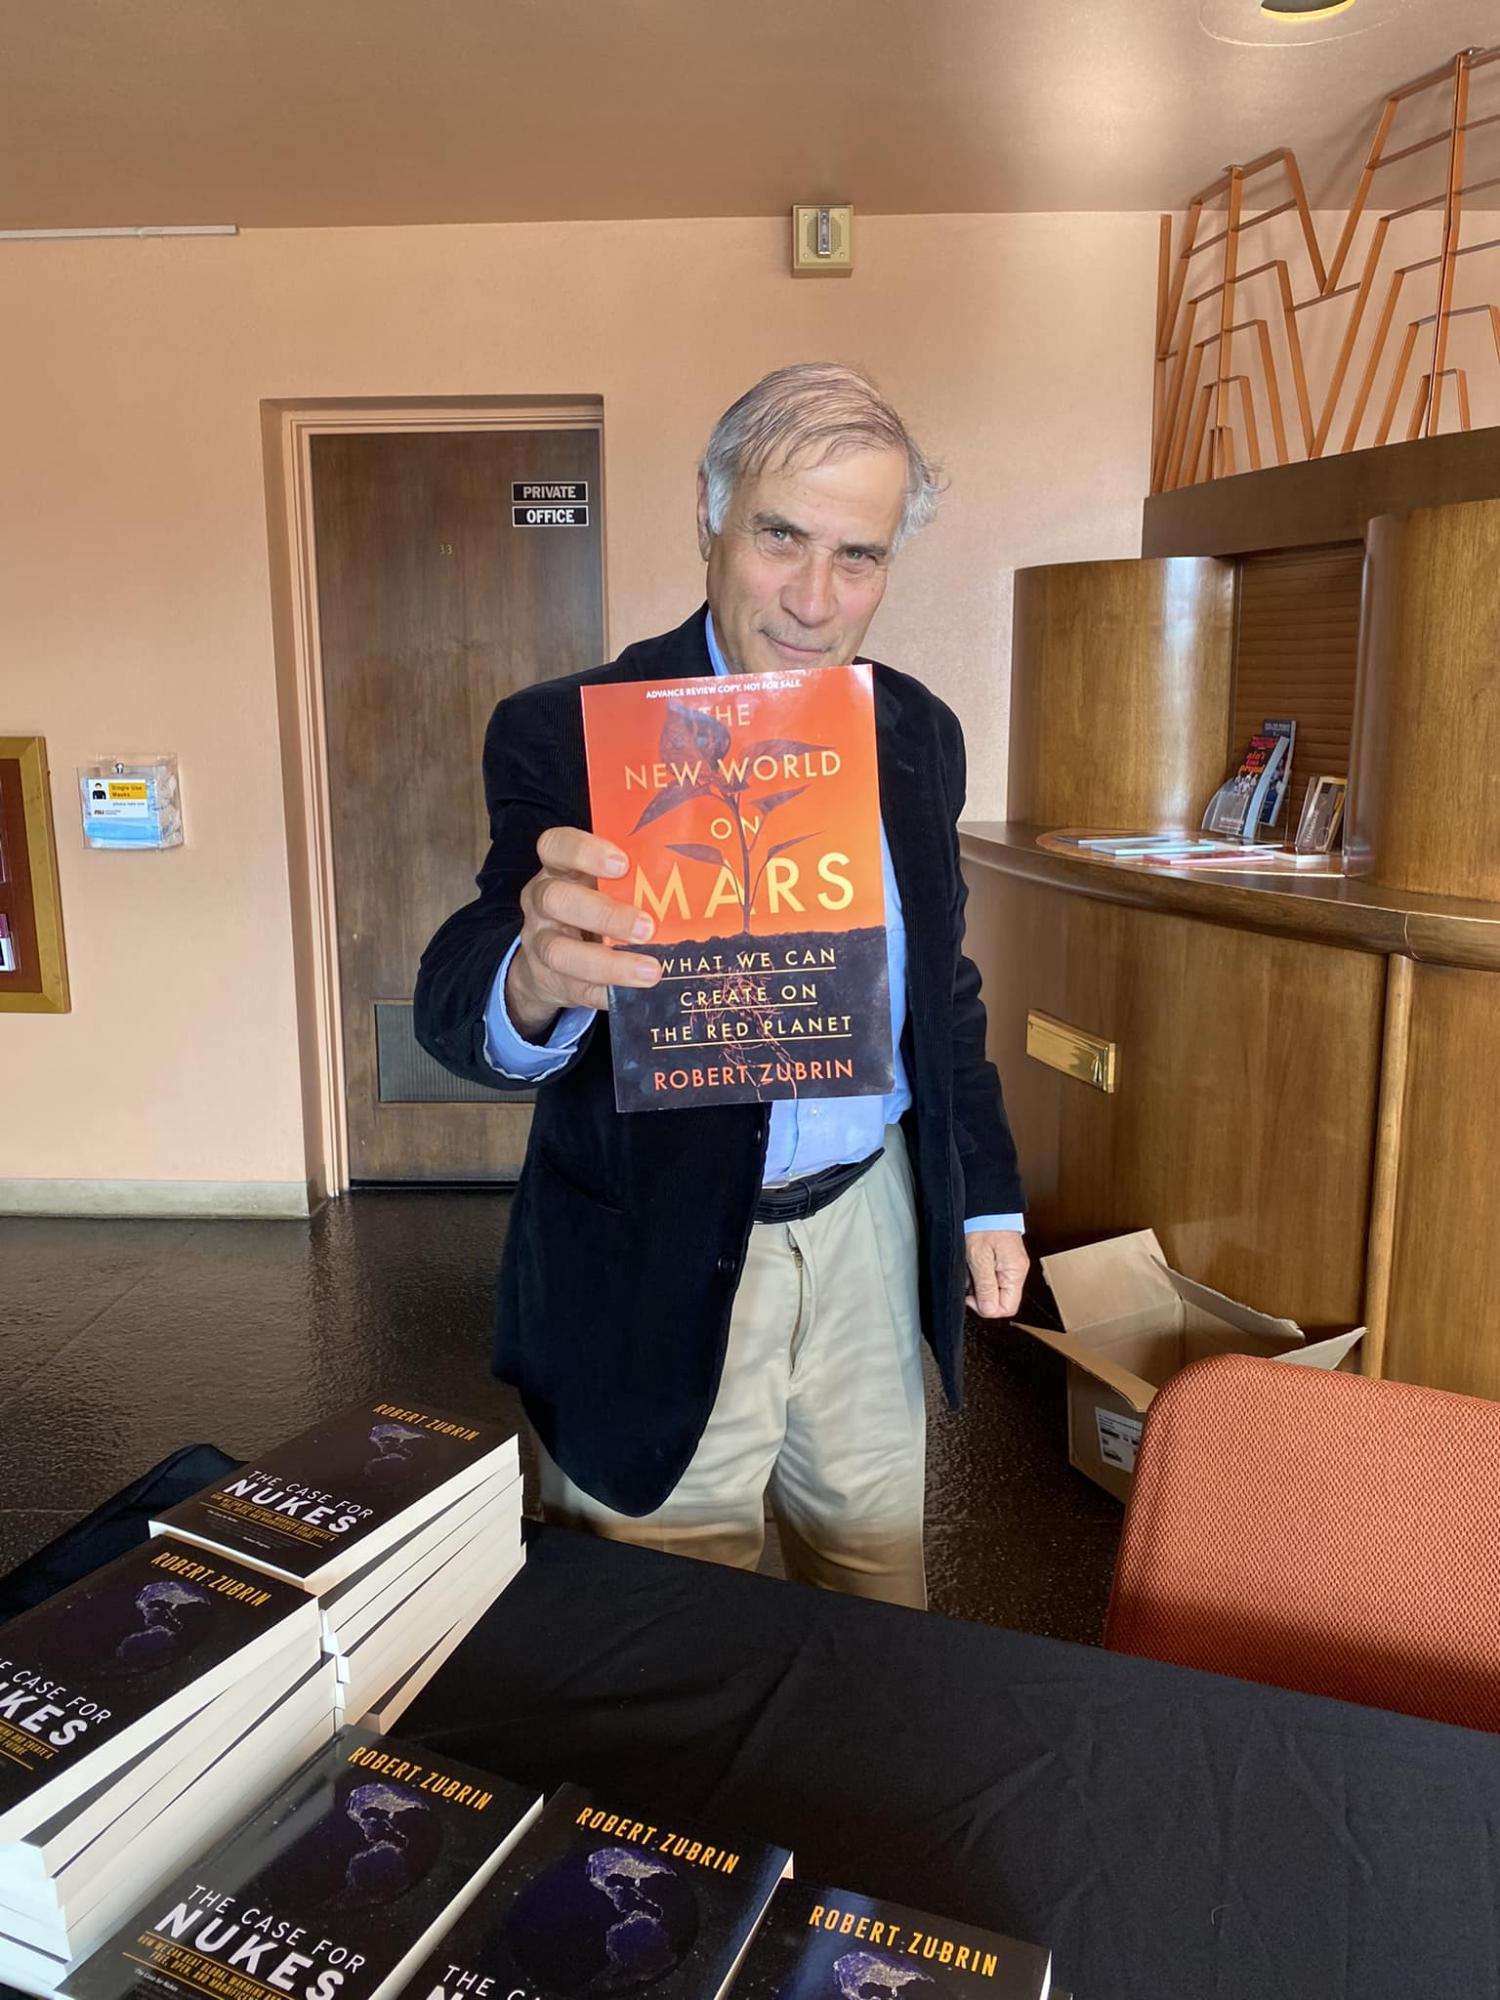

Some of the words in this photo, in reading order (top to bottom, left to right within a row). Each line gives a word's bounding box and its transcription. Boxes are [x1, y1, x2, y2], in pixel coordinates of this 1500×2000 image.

[523, 486, 576, 498] PRIVATE
[526, 509, 575, 524] OFFICE
[646, 687, 684, 698] ADVANCE
[686, 685, 717, 696] REVIEW
[744, 683, 761, 692] NOT
[761, 681, 779, 690] FOR
[625, 760, 702, 790] NEW
[717, 751, 841, 784] WORLD
[710, 816, 760, 840] ON
[633, 852, 854, 922] MARS
[661, 955, 722, 974] WHAT
[737, 952, 771, 969] WE
[785, 948, 836, 965] CAN
[679, 986, 767, 1007] CREATE
[781, 984, 817, 1000] ON
[650, 1024, 692, 1043] THE
[707, 1021, 748, 1039] RED
[764, 1016, 852, 1035] PLANET
[654, 1065, 749, 1091] ROBERT
[760, 1059, 853, 1085] ZUBRIN
[373, 1403, 427, 1426] ROBERT
[426, 1421, 480, 1441] ZUBRIN
[223, 1479, 358, 1533] NUKES
[248, 1470, 282, 1487] THE
[285, 1483, 332, 1504] CASE
[335, 1500, 373, 1519] FOR
[151, 1551, 212, 1583] ROBERT
[208, 1575, 272, 1607] ZUBRIN
[0, 1681, 87, 1746] KES
[13, 1670, 67, 1700] CASE
[65, 1696, 111, 1724] FOR
[348, 1746, 421, 1783] ROBERT
[419, 1771, 492, 1811] ZUBRIN
[575, 1806, 658, 1849] ROBERT
[659, 1832, 739, 1875] ZUBRIN
[154, 1902, 344, 2000] NUKES
[188, 1884, 236, 1914] THE
[241, 1908, 307, 1946] CASE
[312, 1939, 365, 1974] FOR
[808, 1905, 902, 1948] ROBERT
[907, 1932, 998, 1978] ZUBRIN
[443, 1964, 495, 1997] THE
